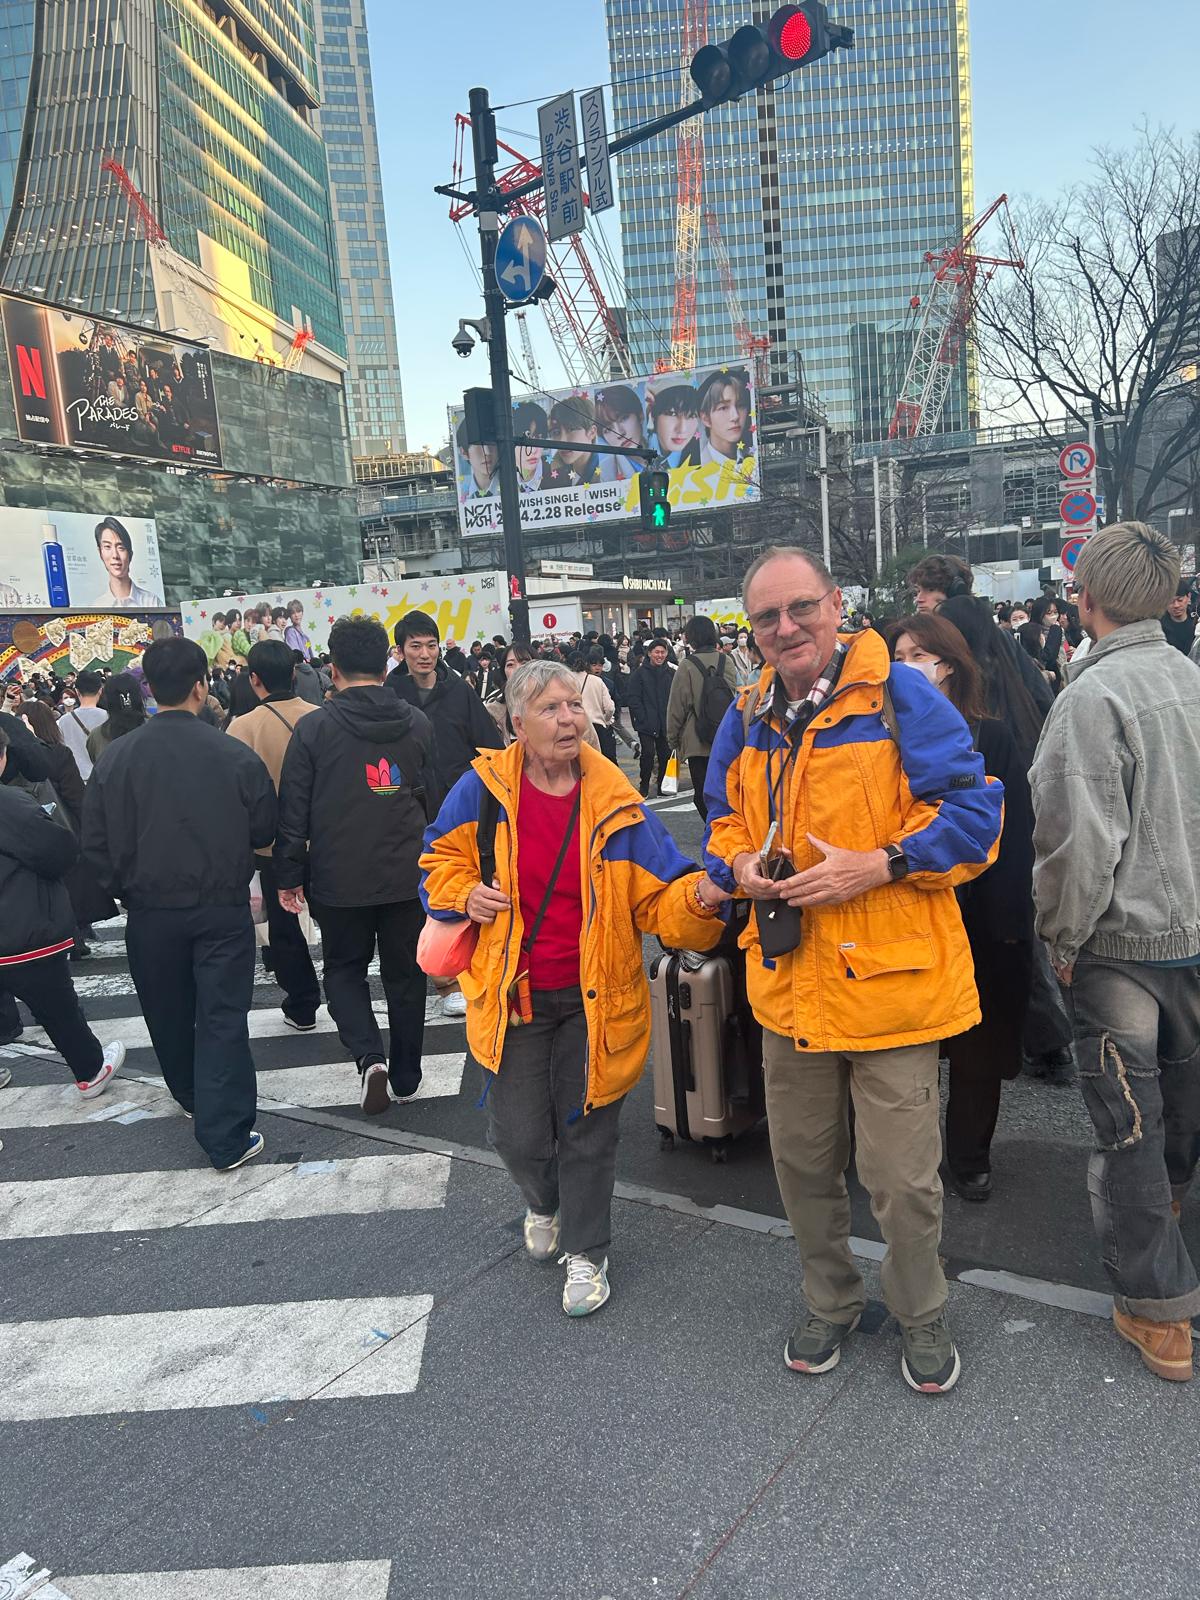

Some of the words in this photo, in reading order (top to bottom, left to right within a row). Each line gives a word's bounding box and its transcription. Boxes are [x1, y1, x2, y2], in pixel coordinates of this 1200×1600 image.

[544, 133, 555, 186] Shibuya
[554, 107, 578, 225] 渋谷駅前
[549, 191, 559, 217] Sta.
[15, 344, 46, 400] N
[66, 398, 139, 431] PARADES
[93, 394, 116, 407] THE
[496, 505, 562, 525] 24.2.28
[564, 501, 622, 518] Release
[544, 492, 579, 505] SINGLE
